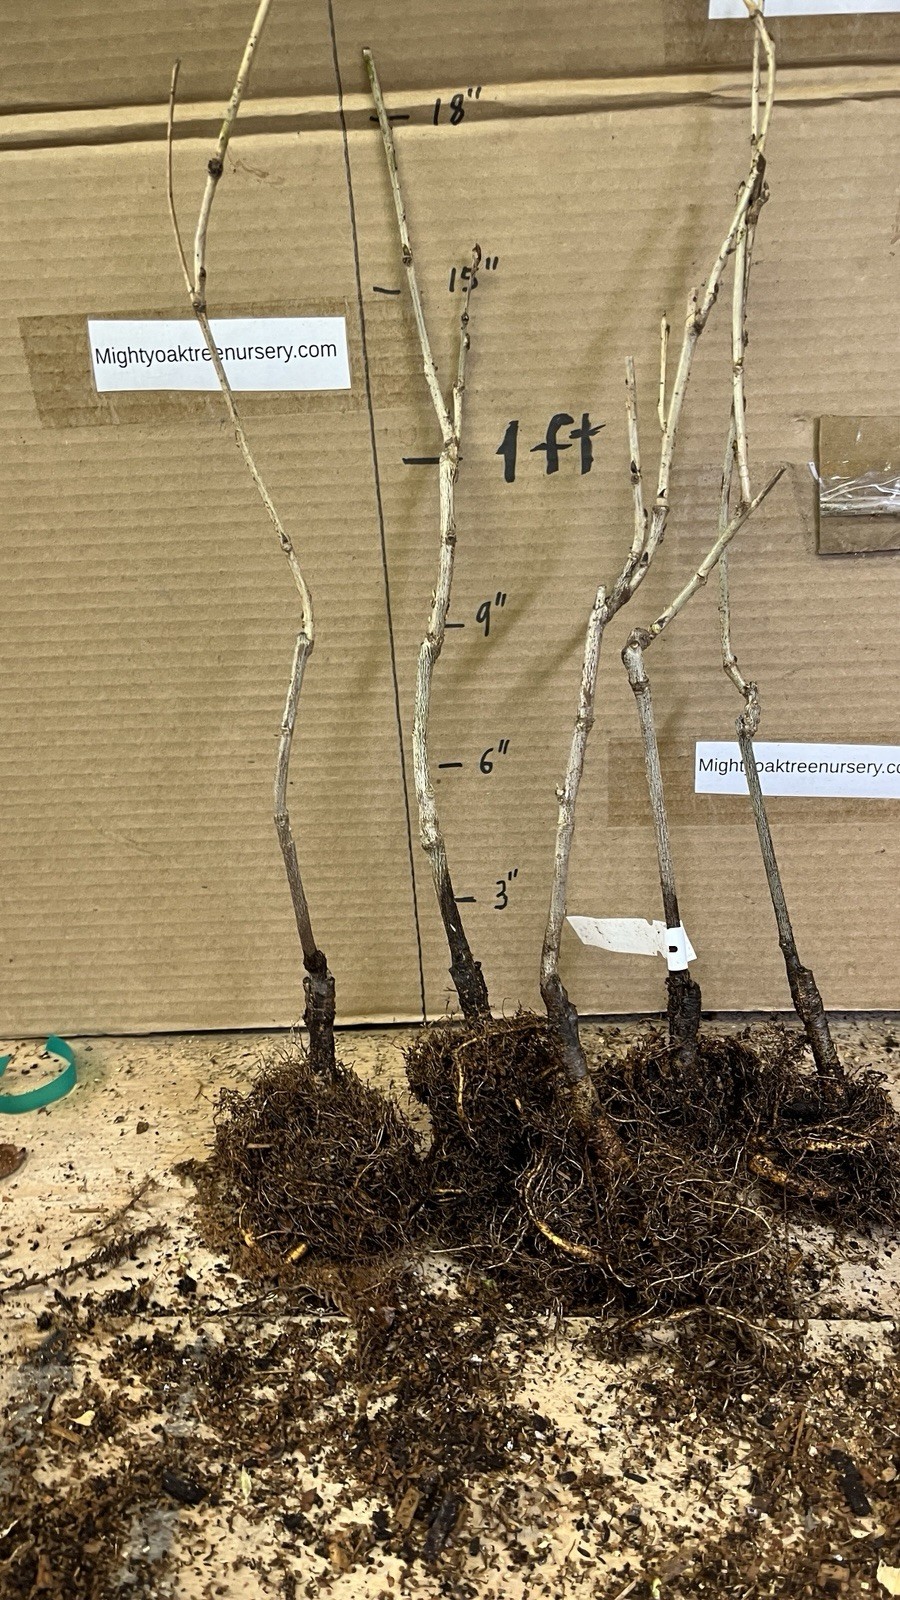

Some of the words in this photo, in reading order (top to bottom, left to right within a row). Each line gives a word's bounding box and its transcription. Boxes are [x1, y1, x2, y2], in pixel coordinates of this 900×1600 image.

[433, 86, 482, 126] 18"
[475, 591, 507, 637] 9"
[479, 739, 510, 774] 6"
[699, 758, 900, 777] Mightoaktreenursery.c
[494, 868, 518, 910] 3"
